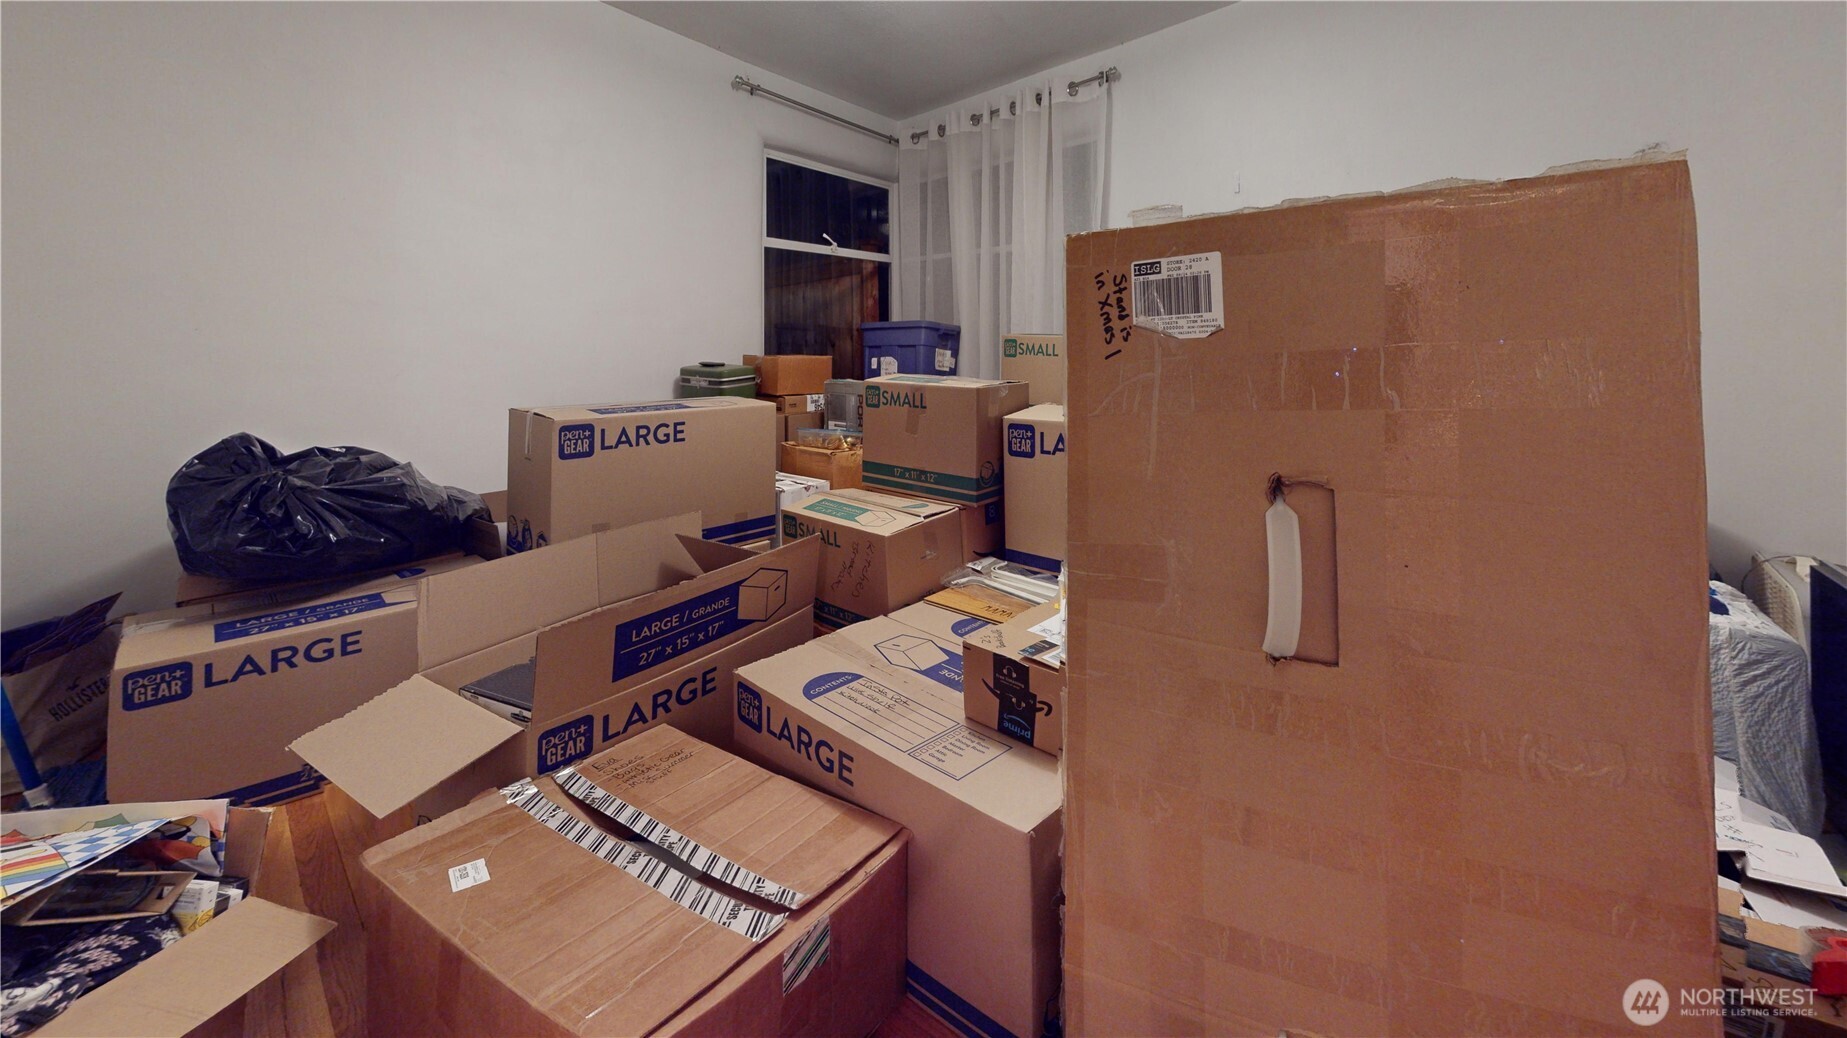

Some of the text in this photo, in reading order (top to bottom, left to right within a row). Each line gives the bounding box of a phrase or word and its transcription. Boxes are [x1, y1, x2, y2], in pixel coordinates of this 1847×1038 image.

[1094, 269, 1110, 291] in
[1134, 263, 1160, 275] ISLG
[1098, 293, 1116, 345] Xmas
[1113, 274, 1132, 342] Stand is
[1018, 343, 1058, 356] SMALL
[882, 390, 927, 409] SMALL
[561, 429, 591, 445] pen+
[564, 440, 590, 454] GEAR
[600, 421, 686, 450] LARGE
[1009, 428, 1032, 441] pen+
[1011, 438, 1031, 453] GEAR
[236, 611, 299, 628] LARGE
[316, 597, 369, 612] GRANDE
[250, 623, 278, 634] 27"
[299, 614, 324, 624] 15"
[342, 605, 365, 615] 17"
[632, 613, 680, 642] LARGE
[692, 597, 730, 619] GRANDE
[639, 620, 724, 666] 27" x 15" x 17"
[204, 630, 363, 689] LARGE
[127, 669, 186, 695] pen+
[133, 680, 182, 704] GEAR
[602, 667, 717, 743] LARGE
[741, 701, 759, 726] GEAR
[542, 724, 588, 756] pen+
[1003, 720, 1031, 739] prime
[547, 736, 586, 766] GEAR
[767, 705, 854, 788] LARGE
[928, 753, 945, 763] Garage
